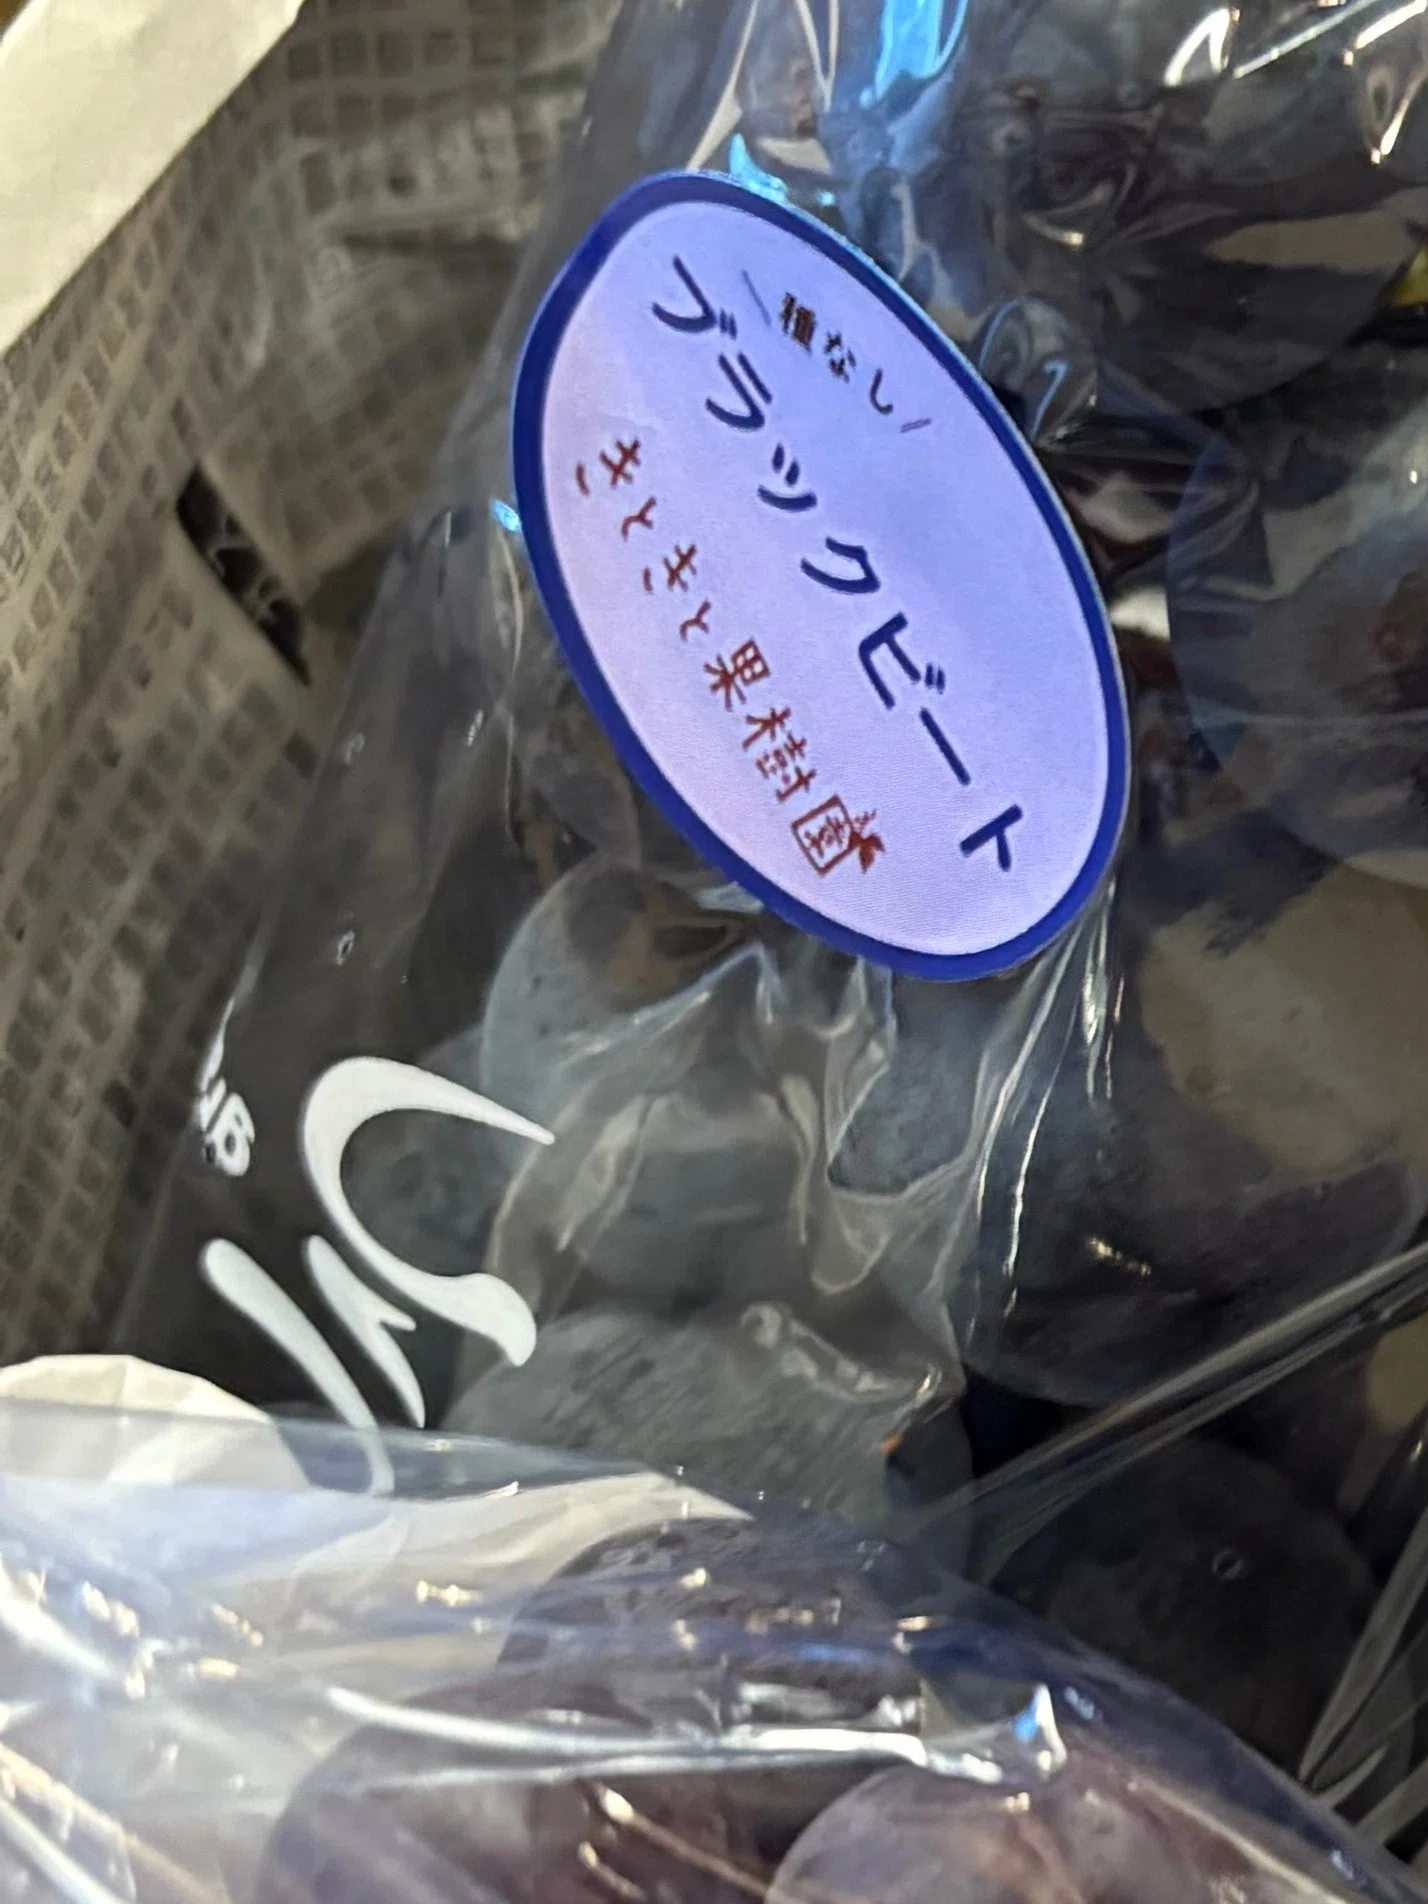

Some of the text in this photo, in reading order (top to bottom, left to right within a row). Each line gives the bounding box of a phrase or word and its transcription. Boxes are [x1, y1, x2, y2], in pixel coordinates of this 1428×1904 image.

[650, 254, 1027, 874] ブラックビート
[775, 286, 900, 418] 種なし
[573, 435, 886, 878] きときと果樹園
